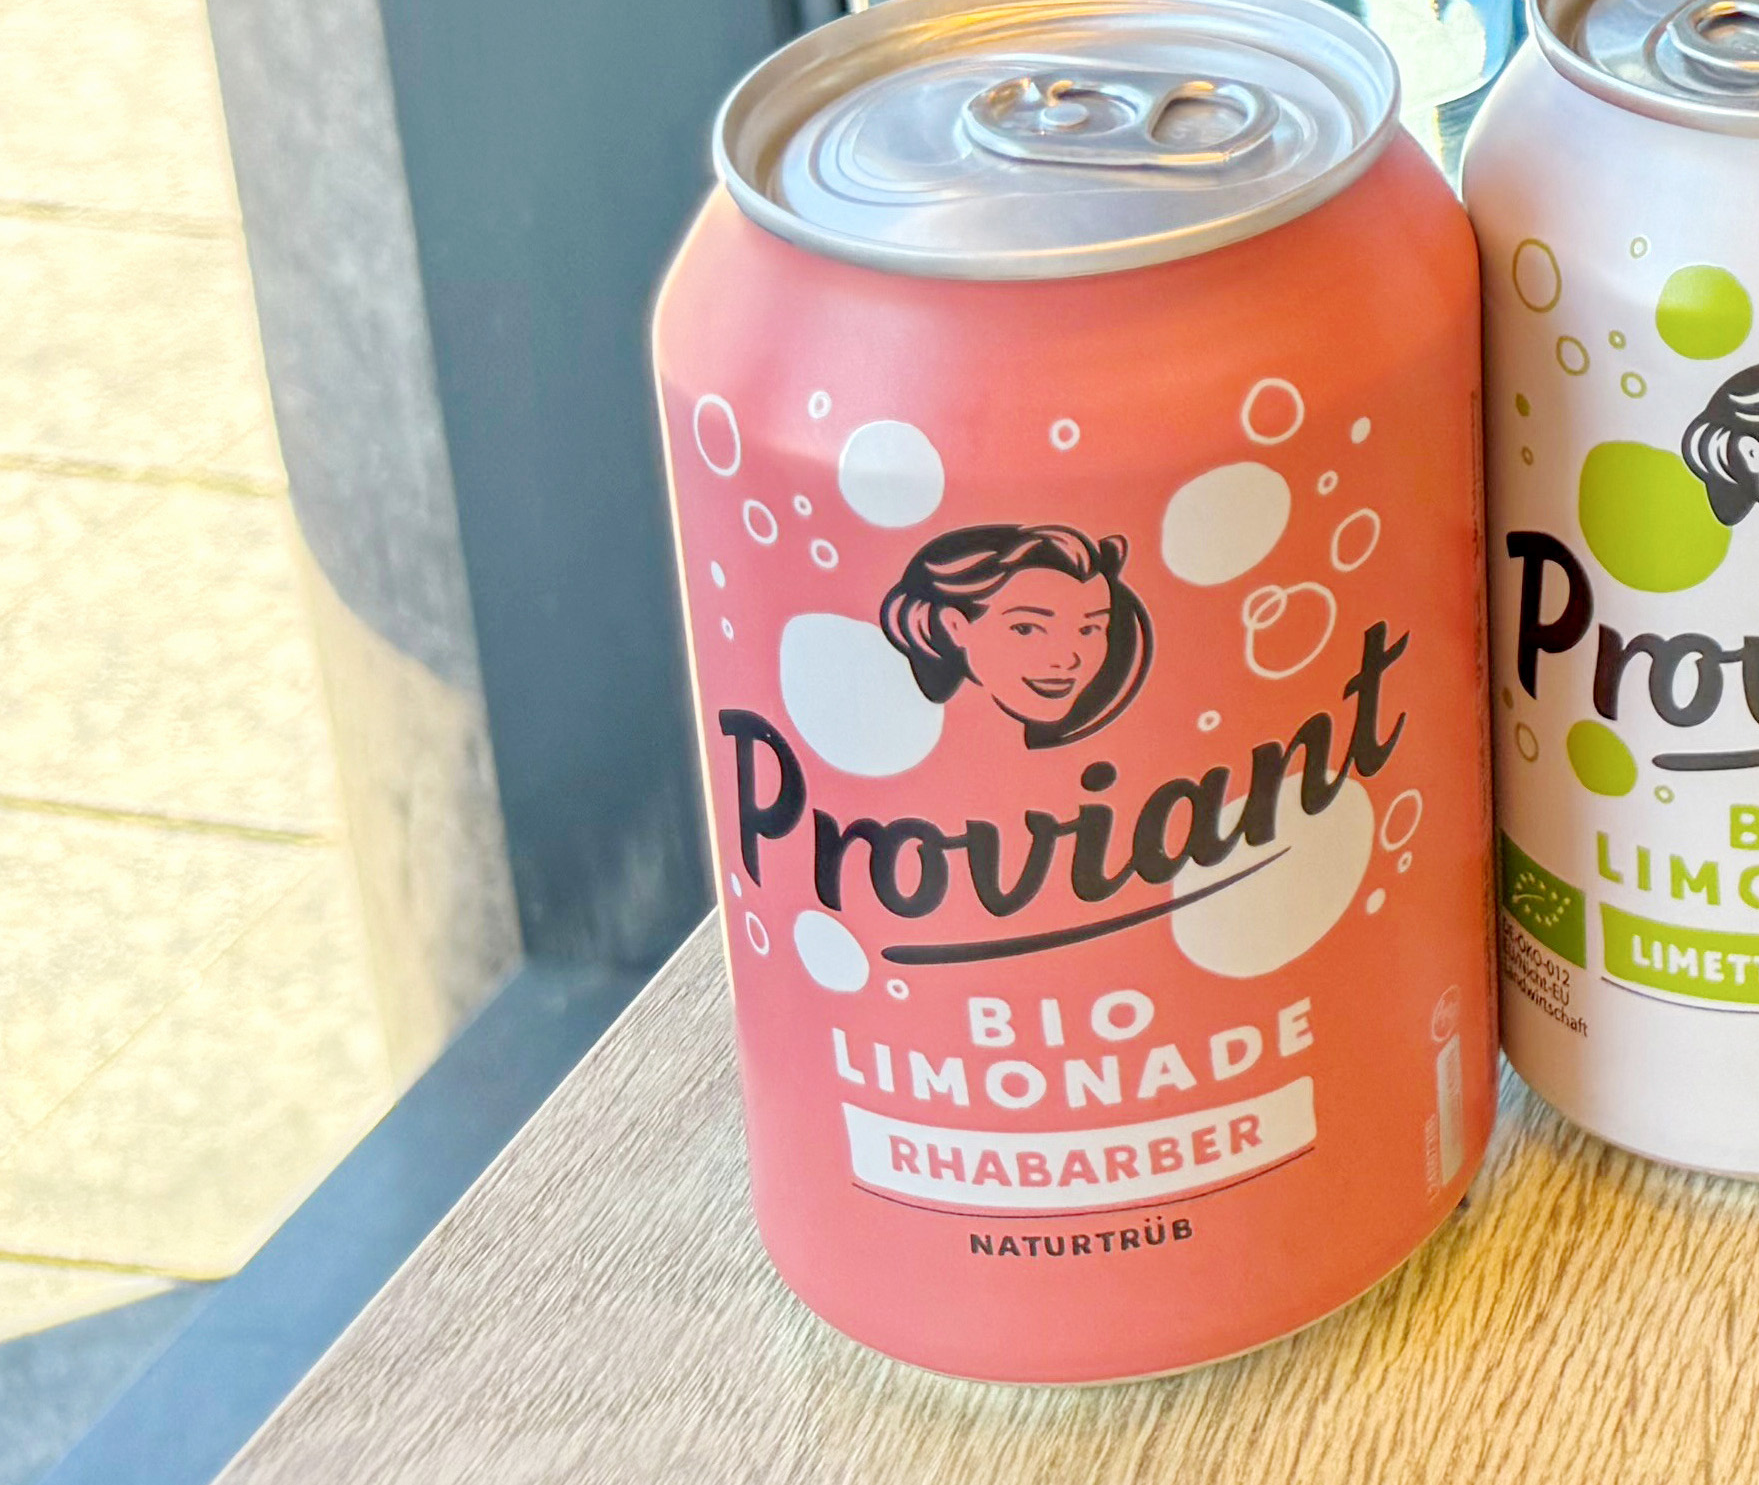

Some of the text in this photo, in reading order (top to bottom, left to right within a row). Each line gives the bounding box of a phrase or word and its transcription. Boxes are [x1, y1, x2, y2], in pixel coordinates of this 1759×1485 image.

[719, 620, 1409, 918] Proviant
[831, 997, 1314, 1110] LIMONADE
[967, 989, 1156, 1048] BIO
[889, 1112, 1264, 1190] RHABARBER
[970, 1218, 1195, 1259] NATURTRÜB
